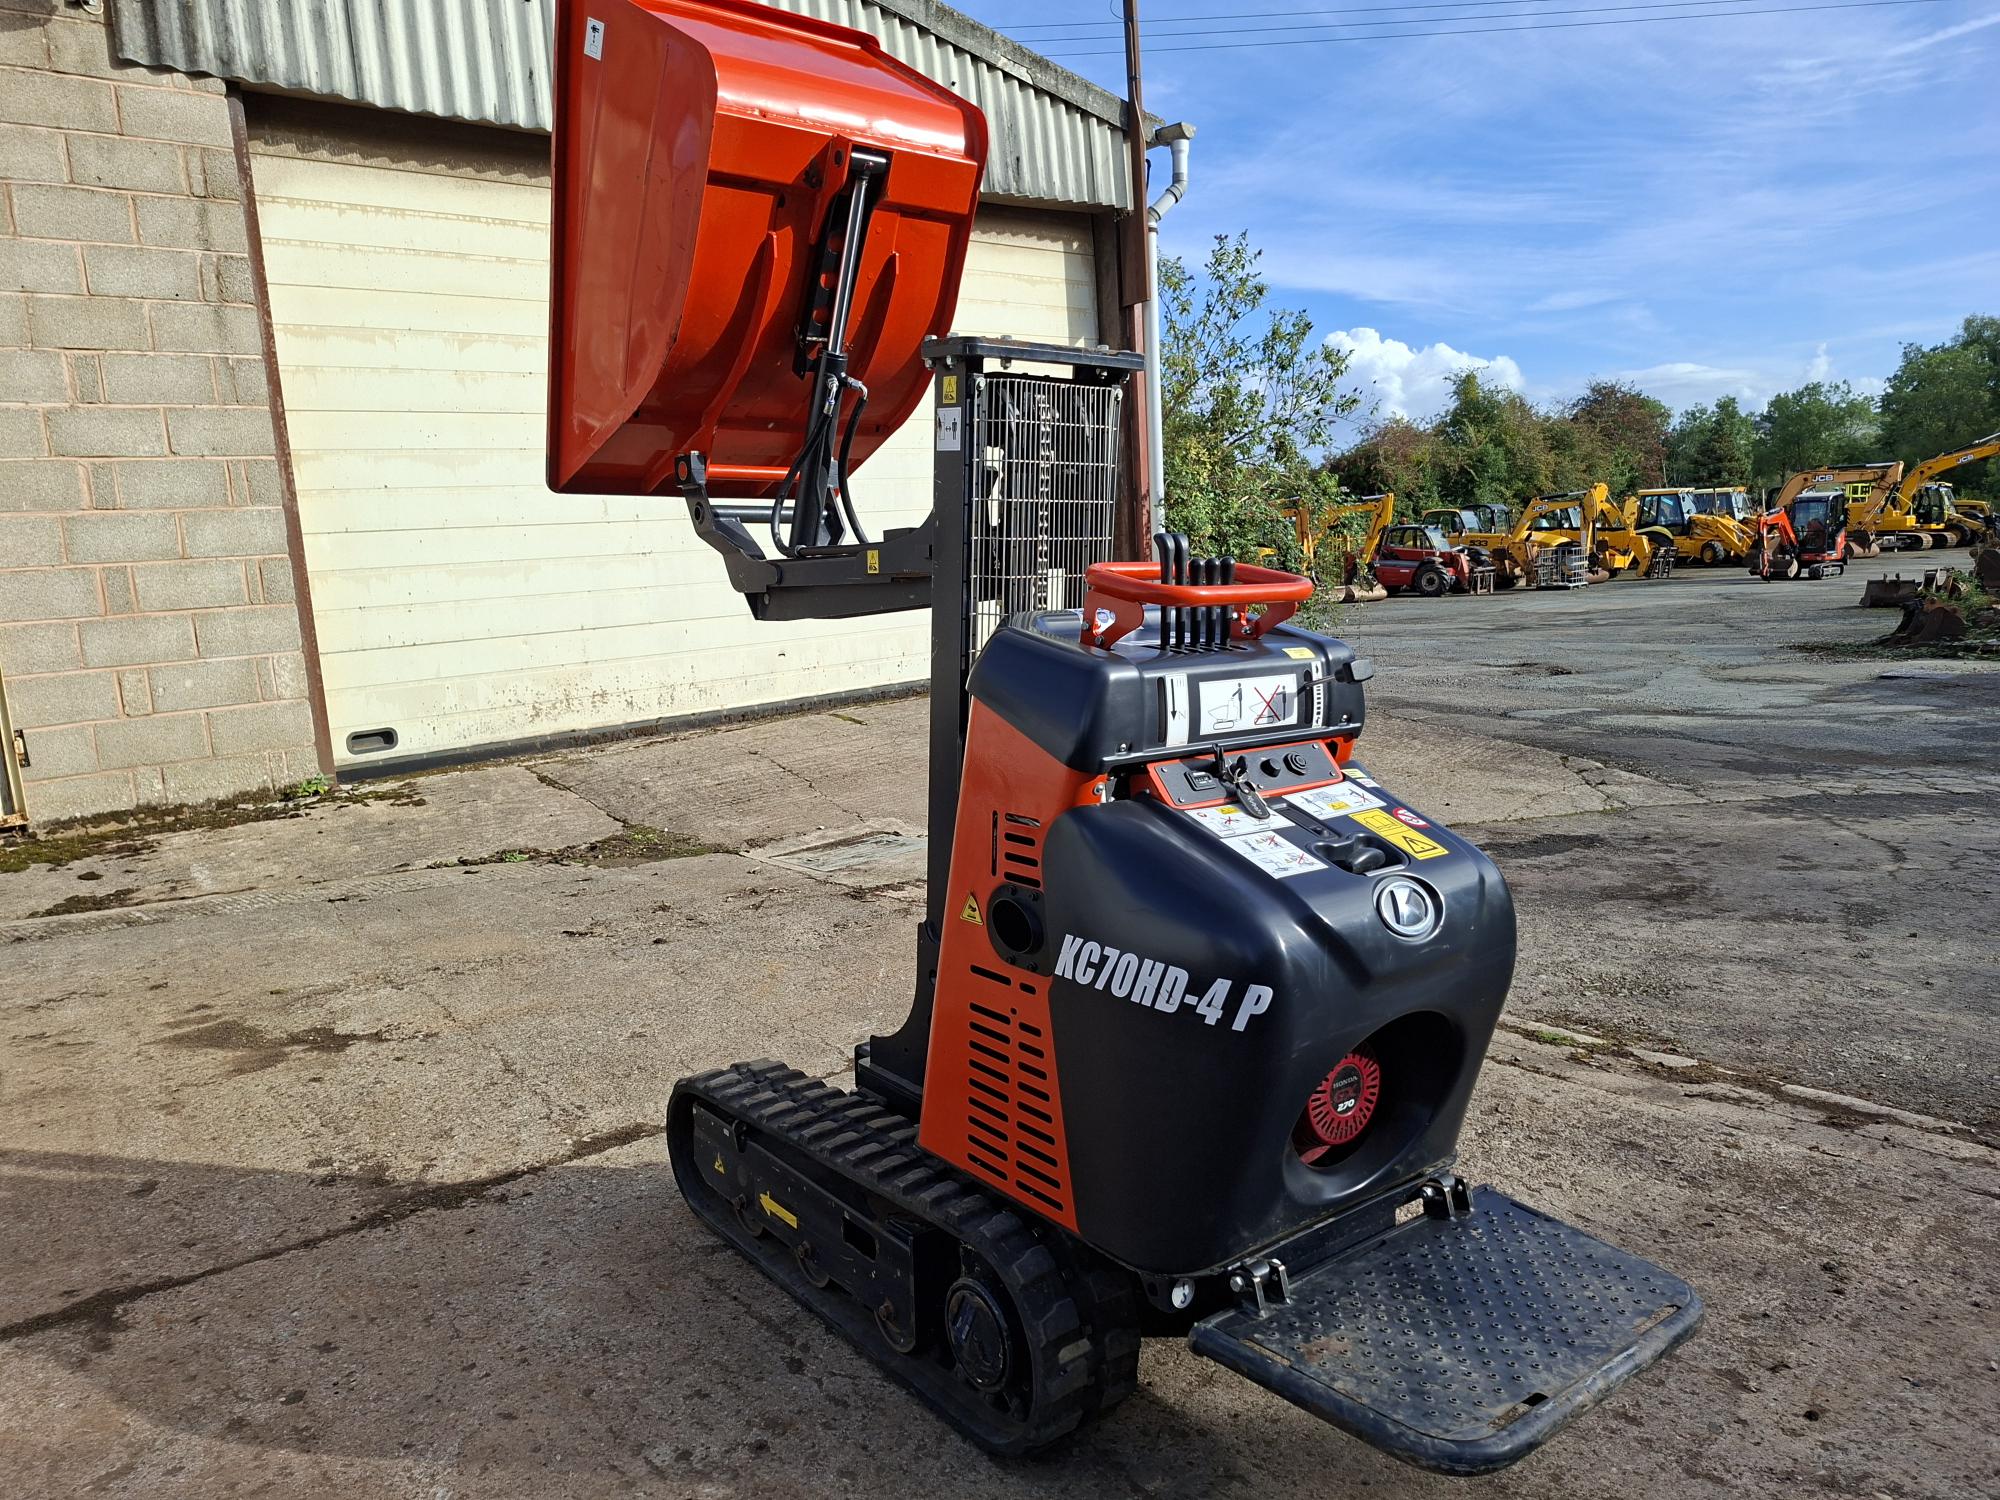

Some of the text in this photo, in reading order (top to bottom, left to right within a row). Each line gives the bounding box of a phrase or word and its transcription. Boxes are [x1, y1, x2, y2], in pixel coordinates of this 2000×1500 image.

[1956, 455, 1974, 464] JCB
[1812, 474, 1834, 482] JCB
[1532, 504, 1549, 512] JCB
[1054, 933, 1274, 1032] KC70HD-4 P
[1333, 1075, 1358, 1089] HONDA
[1337, 1098, 1355, 1112] 270
